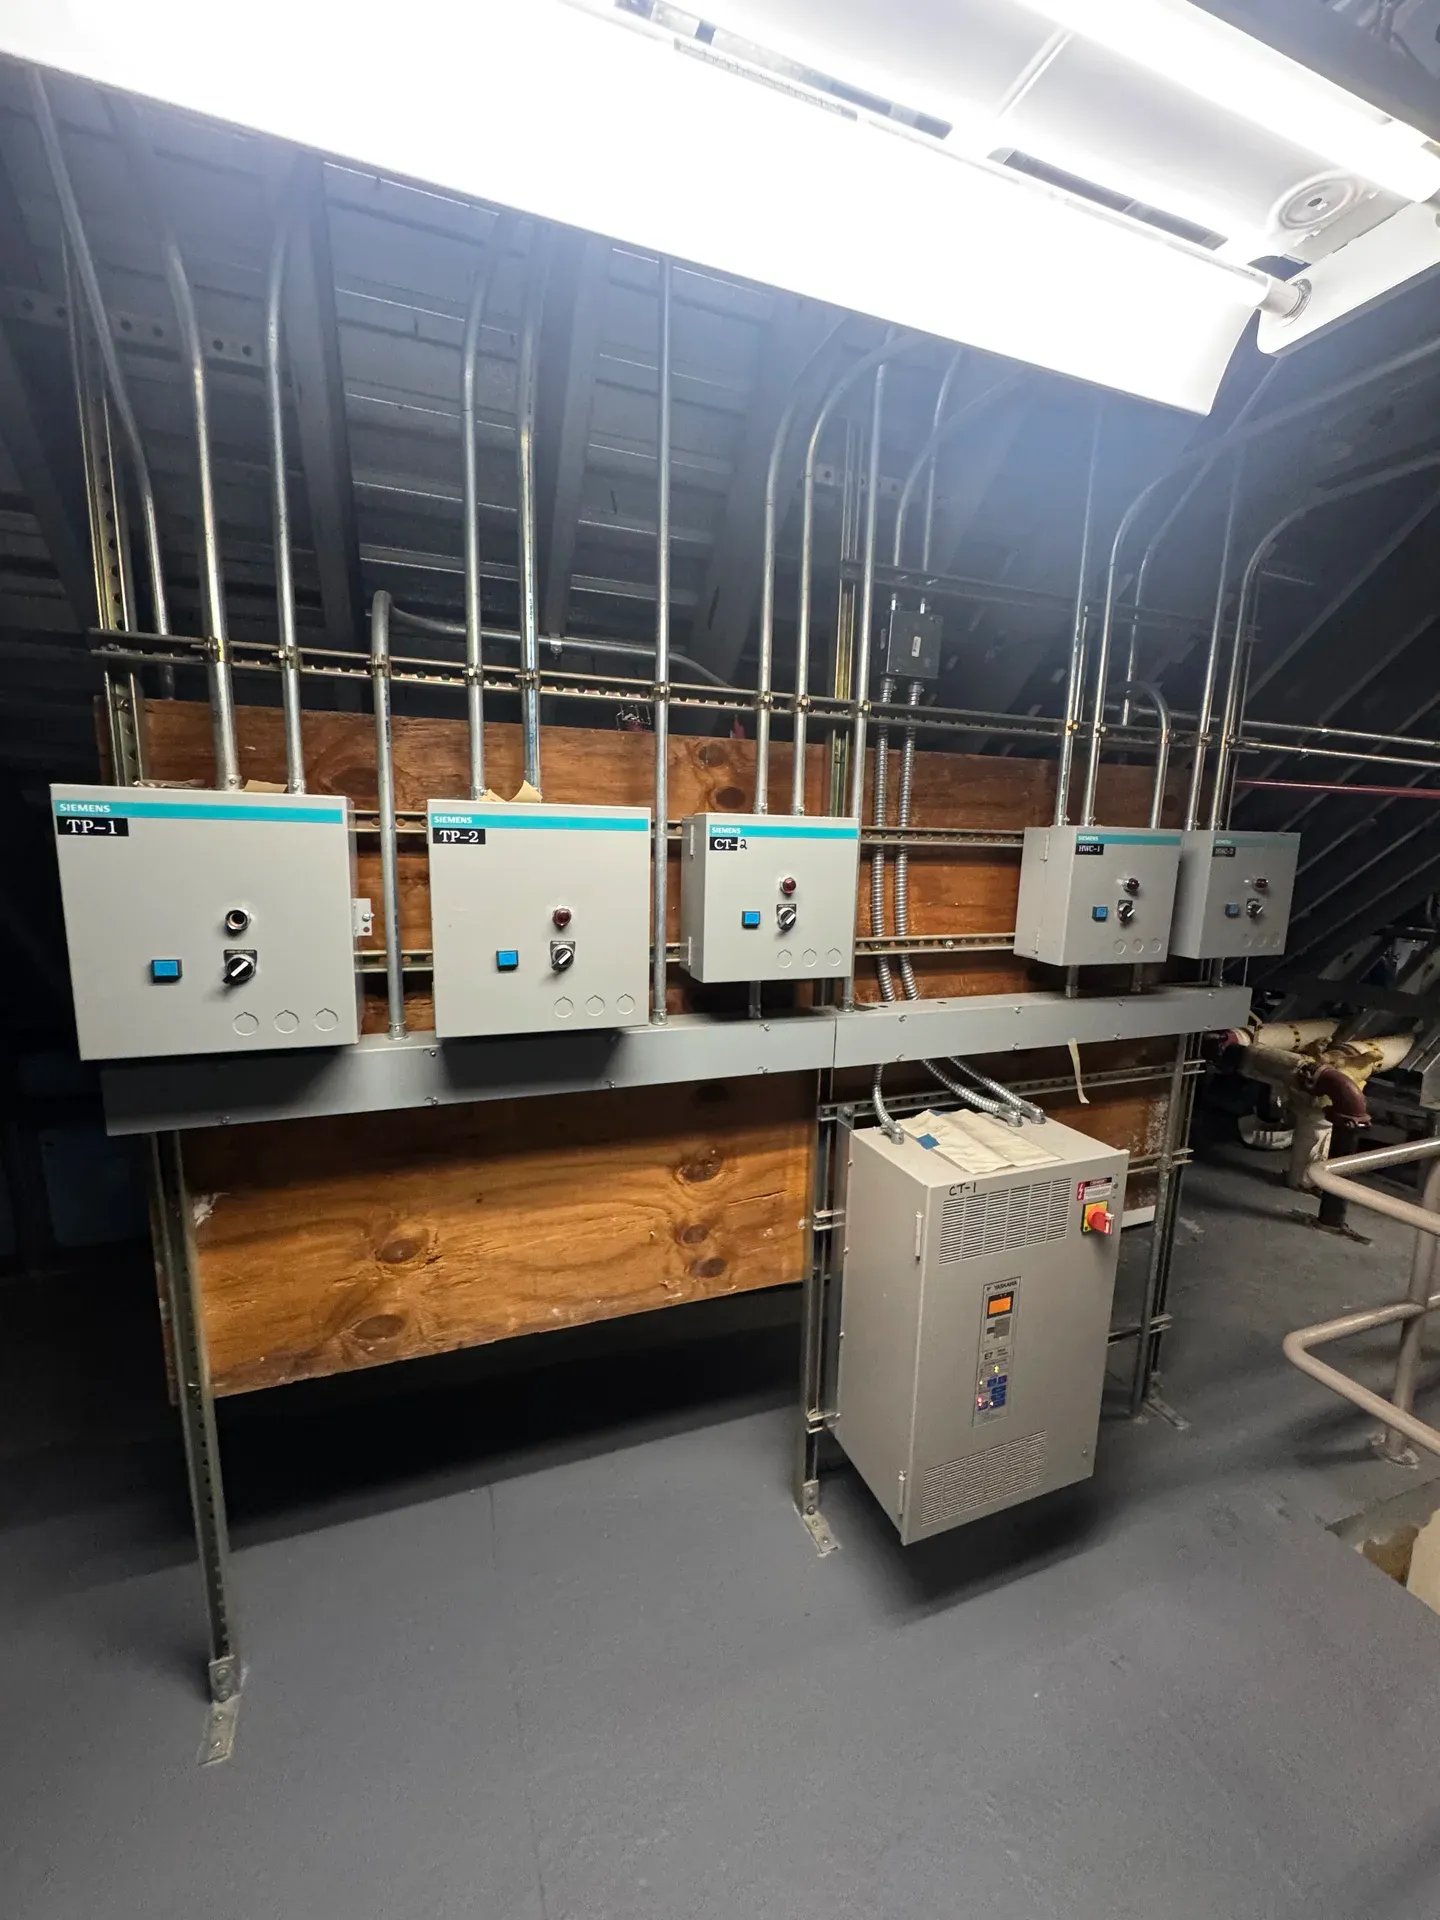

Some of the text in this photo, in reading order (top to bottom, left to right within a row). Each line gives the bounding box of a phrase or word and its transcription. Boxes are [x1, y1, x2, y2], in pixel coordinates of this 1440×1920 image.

[60, 804, 110, 812] SIEMENS
[66, 819, 117, 834] TP-1
[439, 830, 479, 842] TP-2
[949, 1182, 976, 1196] CT-1
